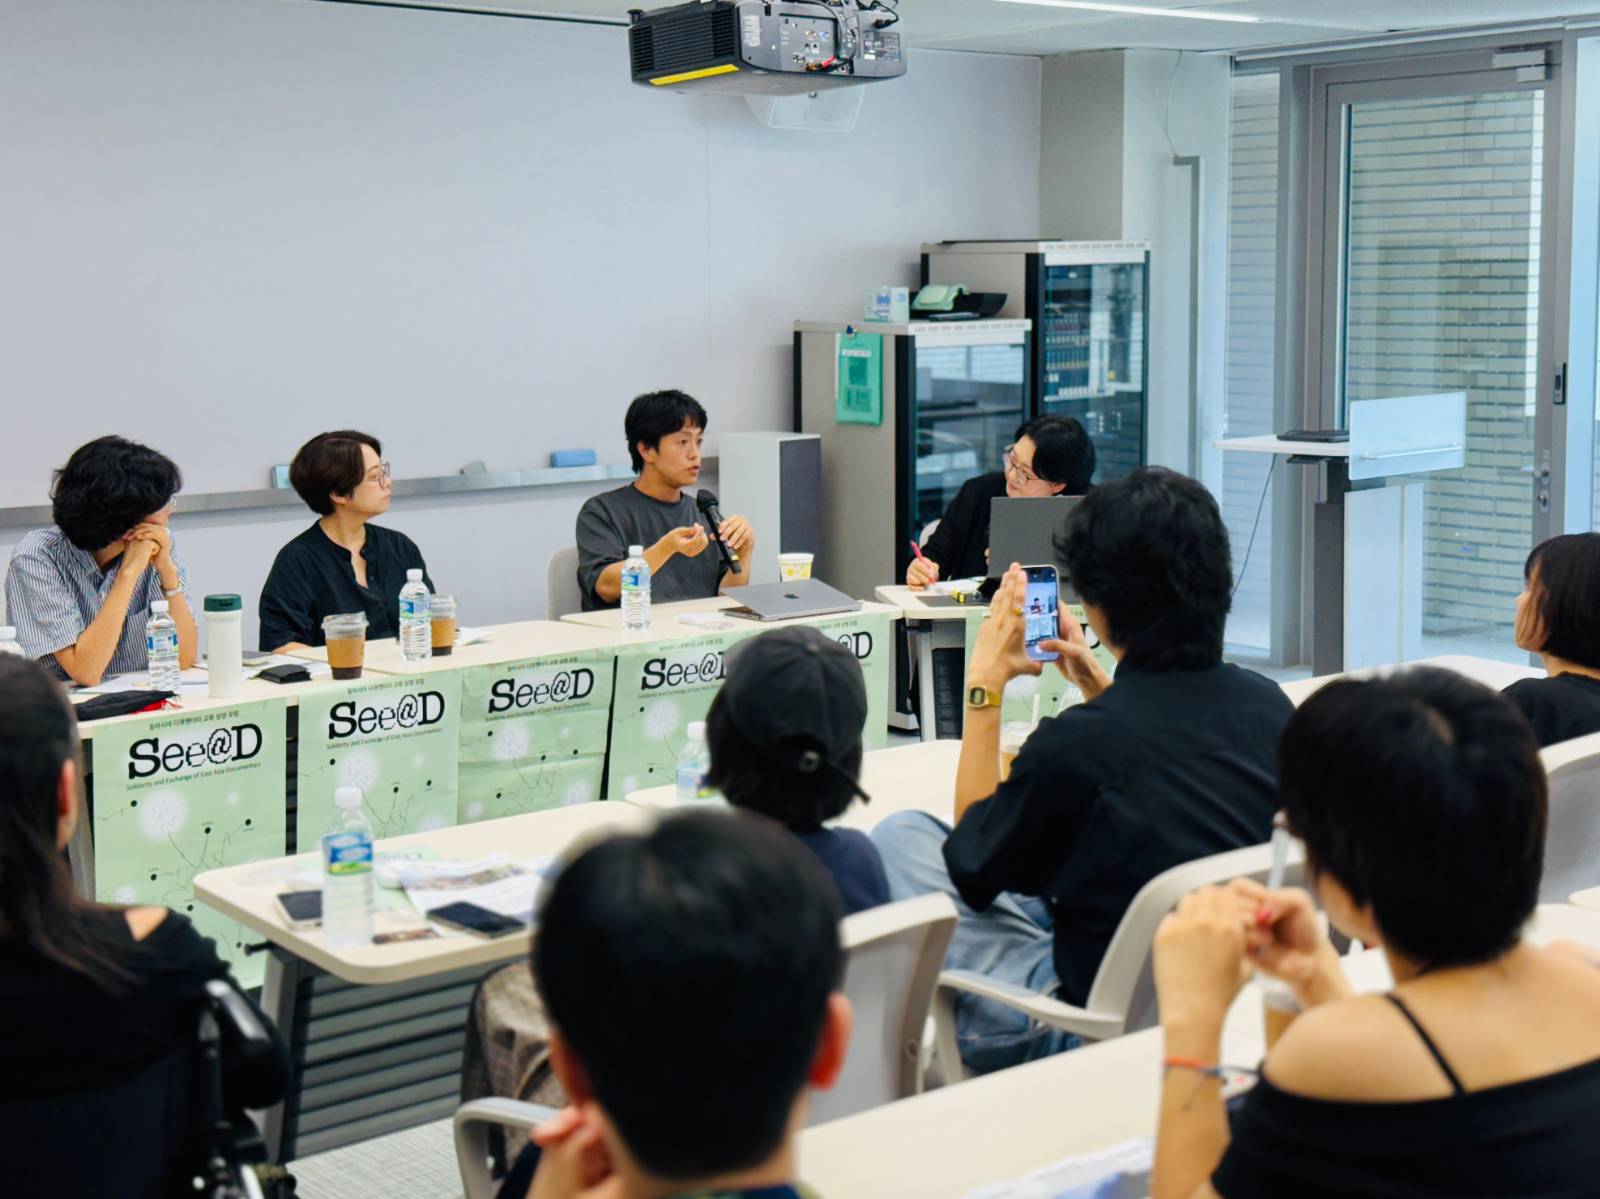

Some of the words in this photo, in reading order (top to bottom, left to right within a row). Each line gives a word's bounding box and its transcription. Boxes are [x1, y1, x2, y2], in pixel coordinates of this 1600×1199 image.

[328, 690, 445, 740] See@D
[487, 668, 595, 714] See@D
[128, 723, 263, 780] See@D
